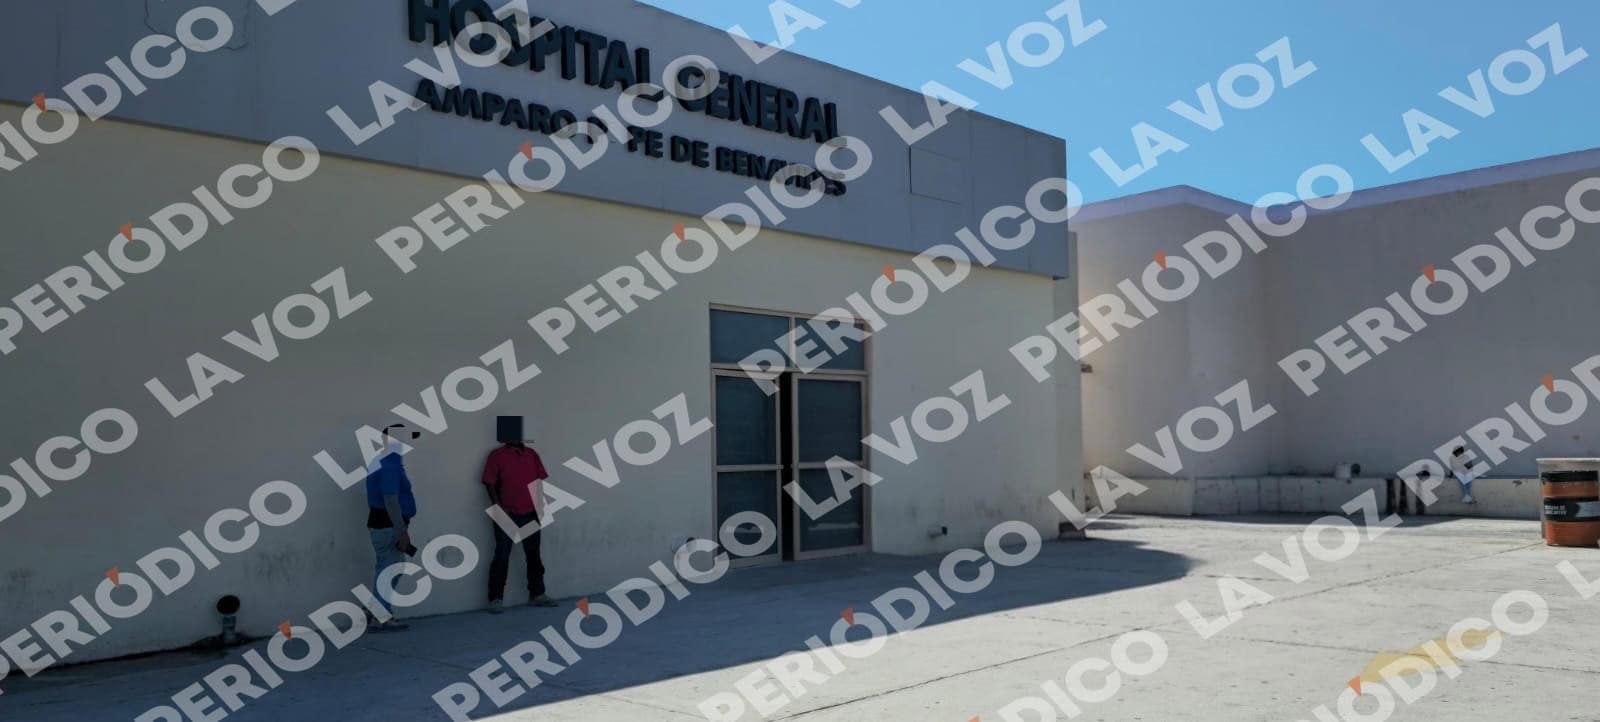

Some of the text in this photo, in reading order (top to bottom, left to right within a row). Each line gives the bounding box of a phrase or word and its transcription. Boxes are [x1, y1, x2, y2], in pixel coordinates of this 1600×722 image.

[408, 0, 847, 147] HOSPITAL GENERAL
[414, 78, 577, 135] AMPARO
[671, 135, 710, 168] DE
